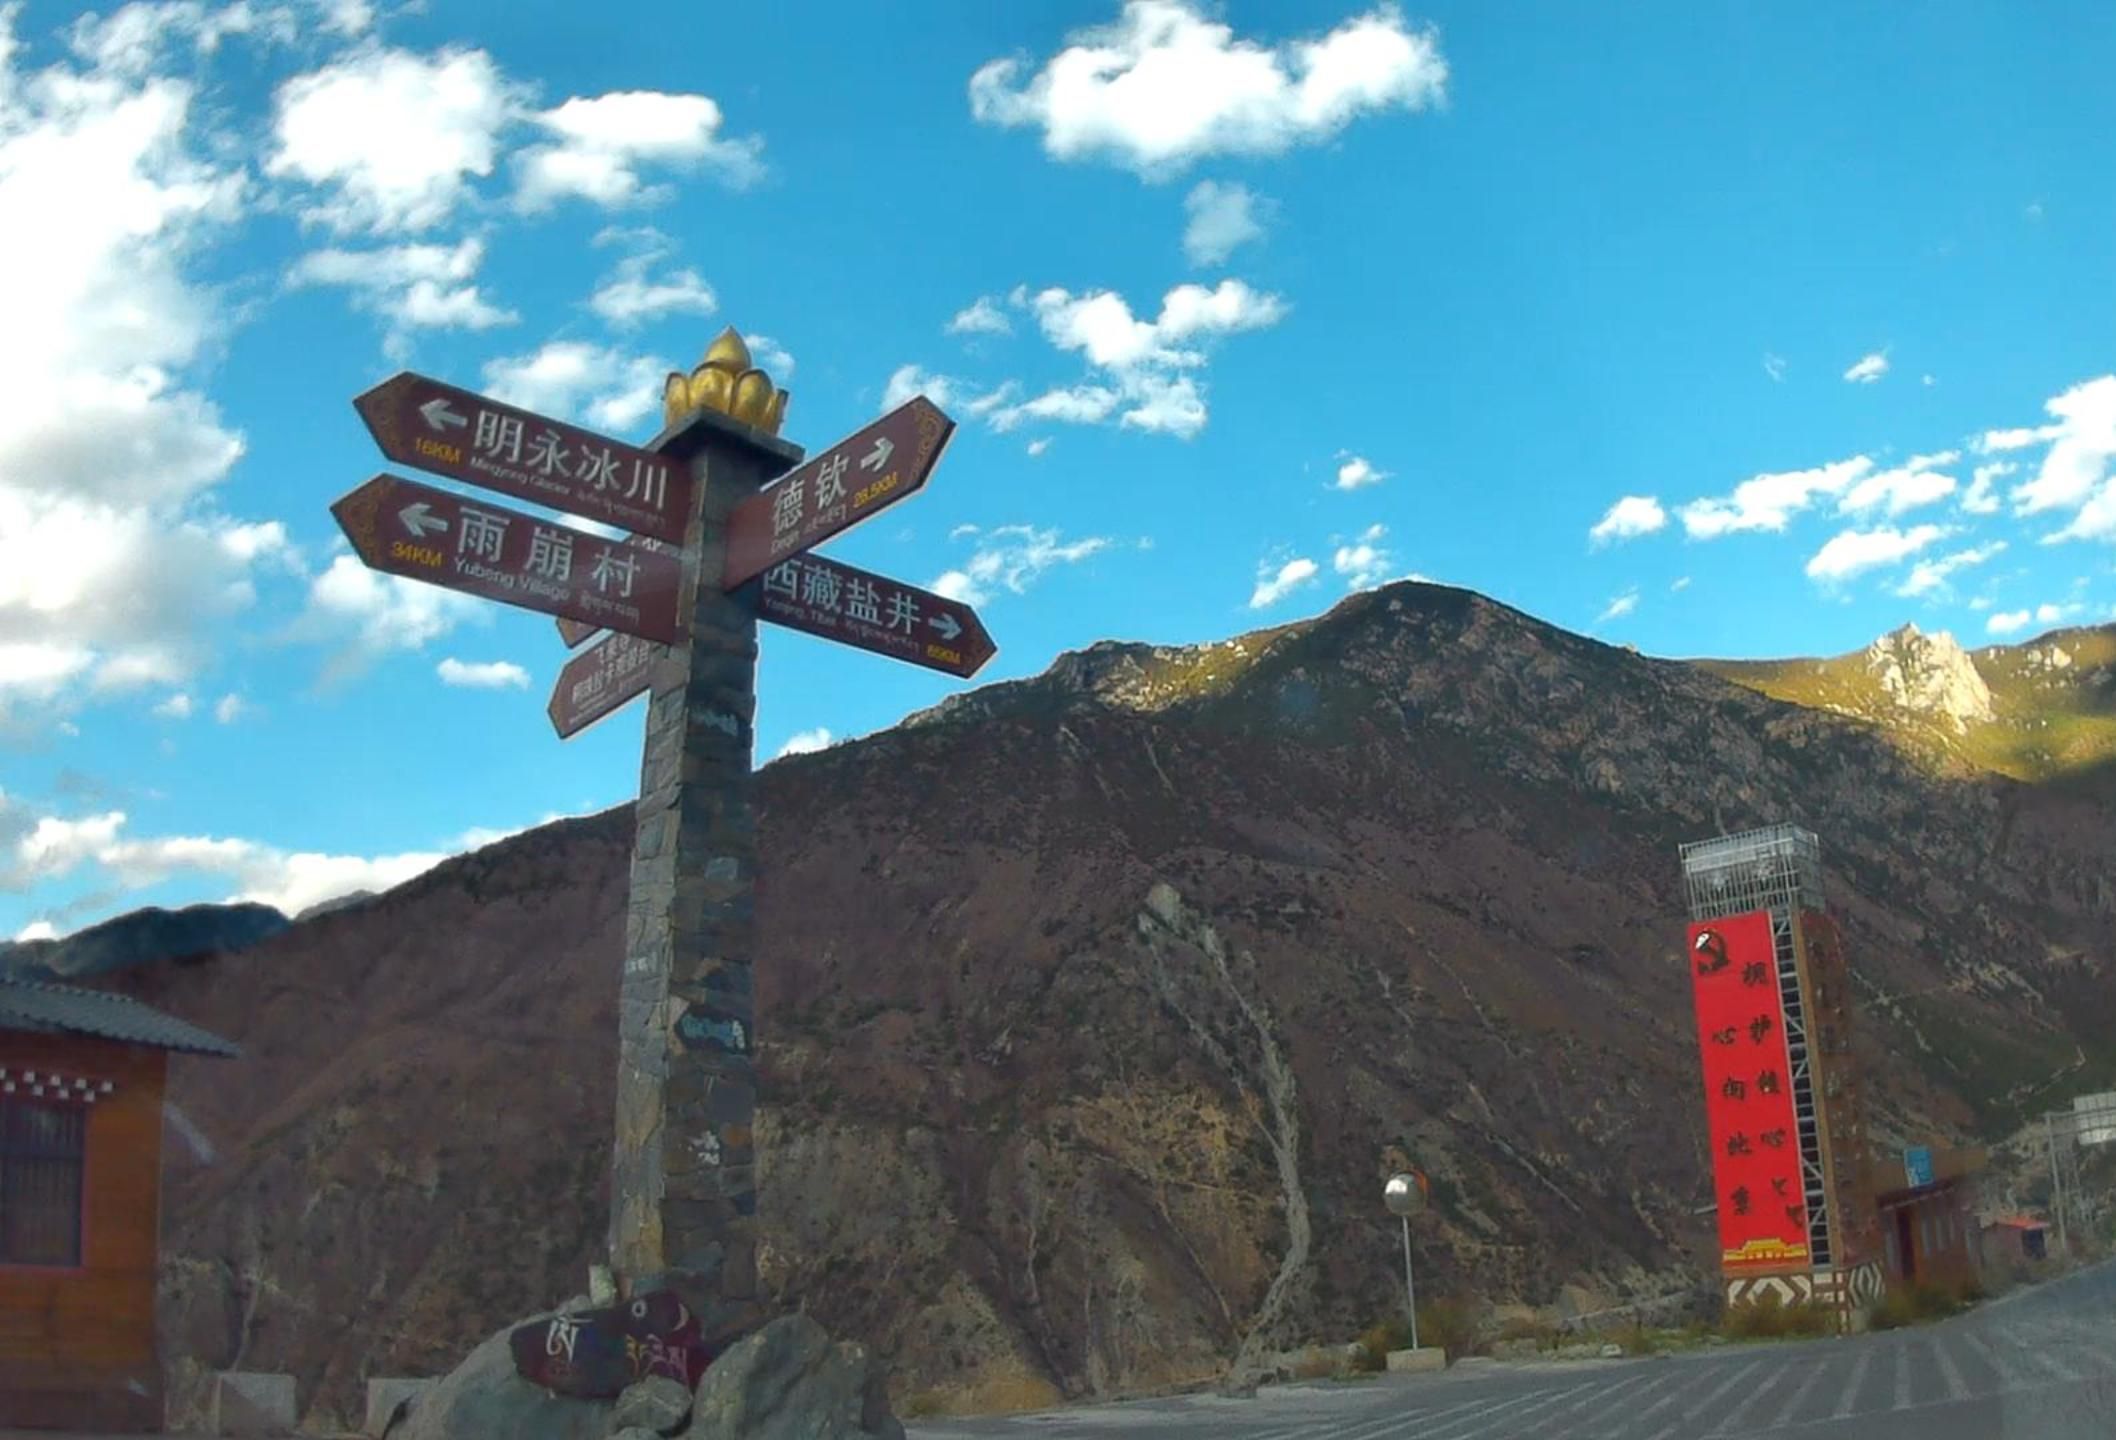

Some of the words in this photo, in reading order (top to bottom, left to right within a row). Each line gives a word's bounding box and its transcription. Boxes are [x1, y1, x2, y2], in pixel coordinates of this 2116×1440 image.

[474, 409, 667, 510] 明永冰川
[771, 453, 850, 537] 德钦
[454, 556, 515, 590] Yubeng
[518, 574, 571, 601] Village
[457, 506, 641, 598] 雨崩村
[763, 559, 921, 635] 西藏盐井
